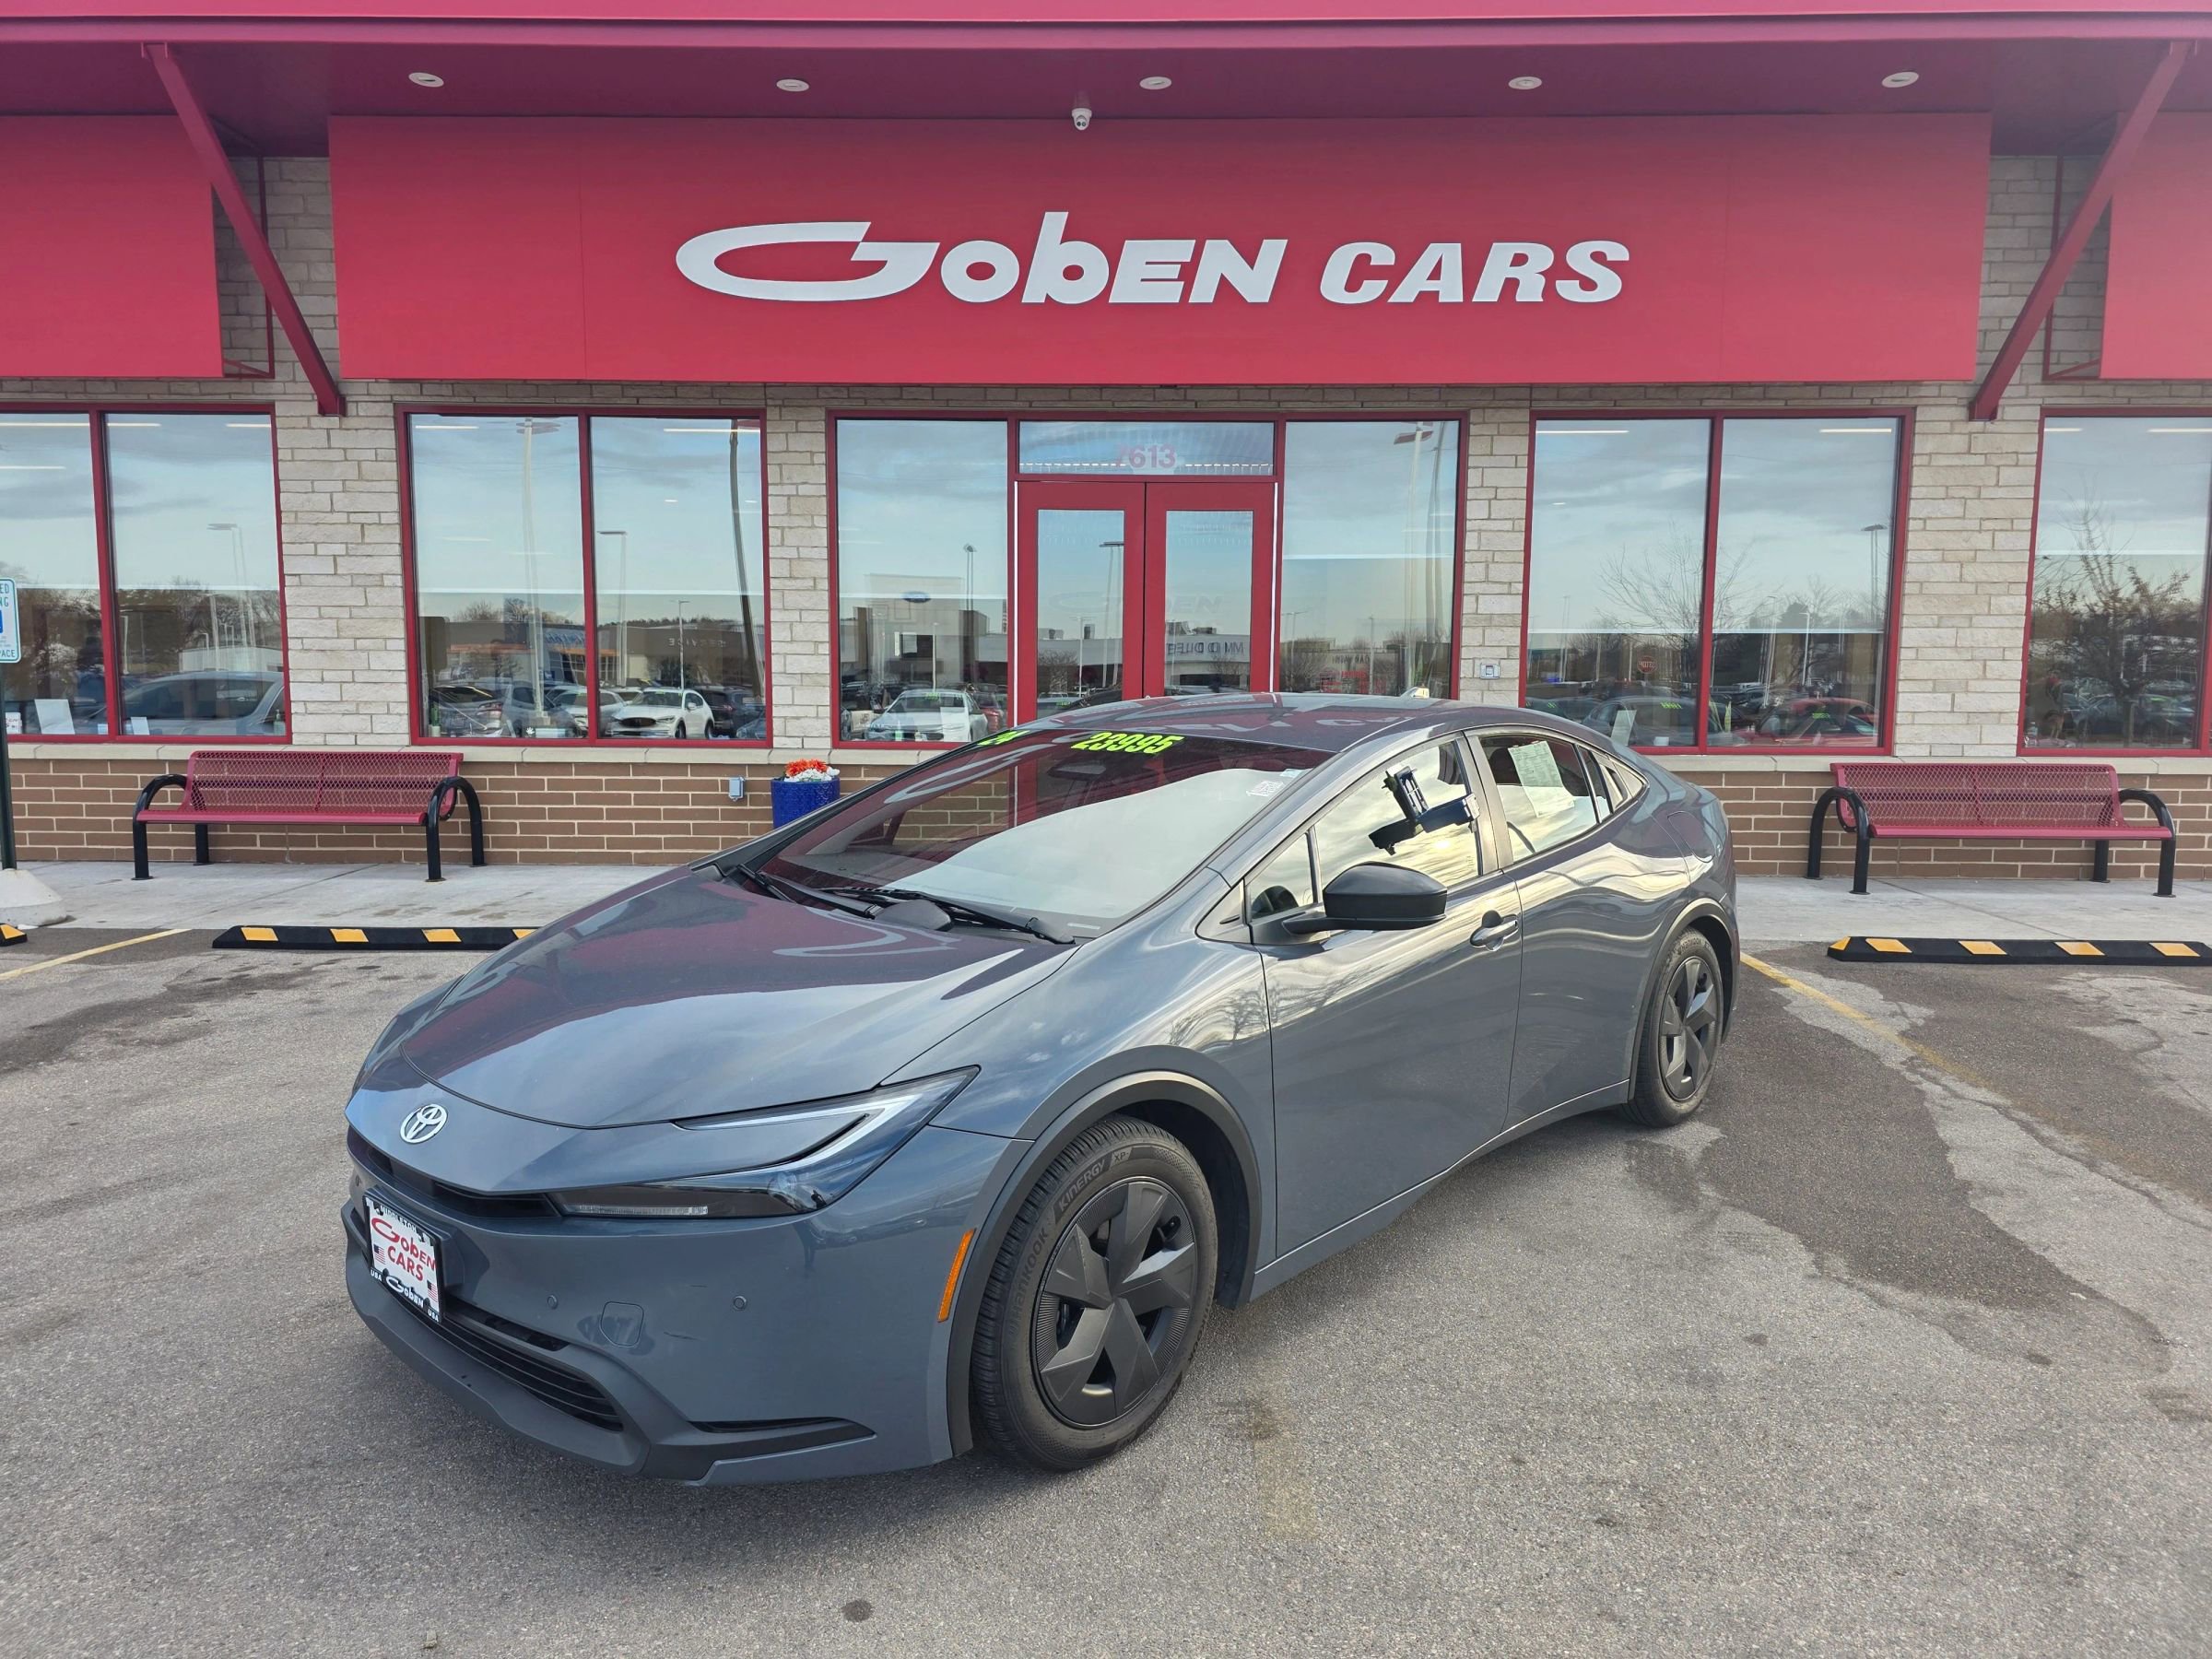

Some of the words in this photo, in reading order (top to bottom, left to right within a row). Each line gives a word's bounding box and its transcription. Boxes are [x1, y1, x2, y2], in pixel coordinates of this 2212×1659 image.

[1319, 241, 1630, 305] CARS
[1070, 731, 1185, 754] 23995
[387, 1245, 424, 1281] CARS
[371, 1268, 382, 1282] USA
[428, 1308, 439, 1323] USA
